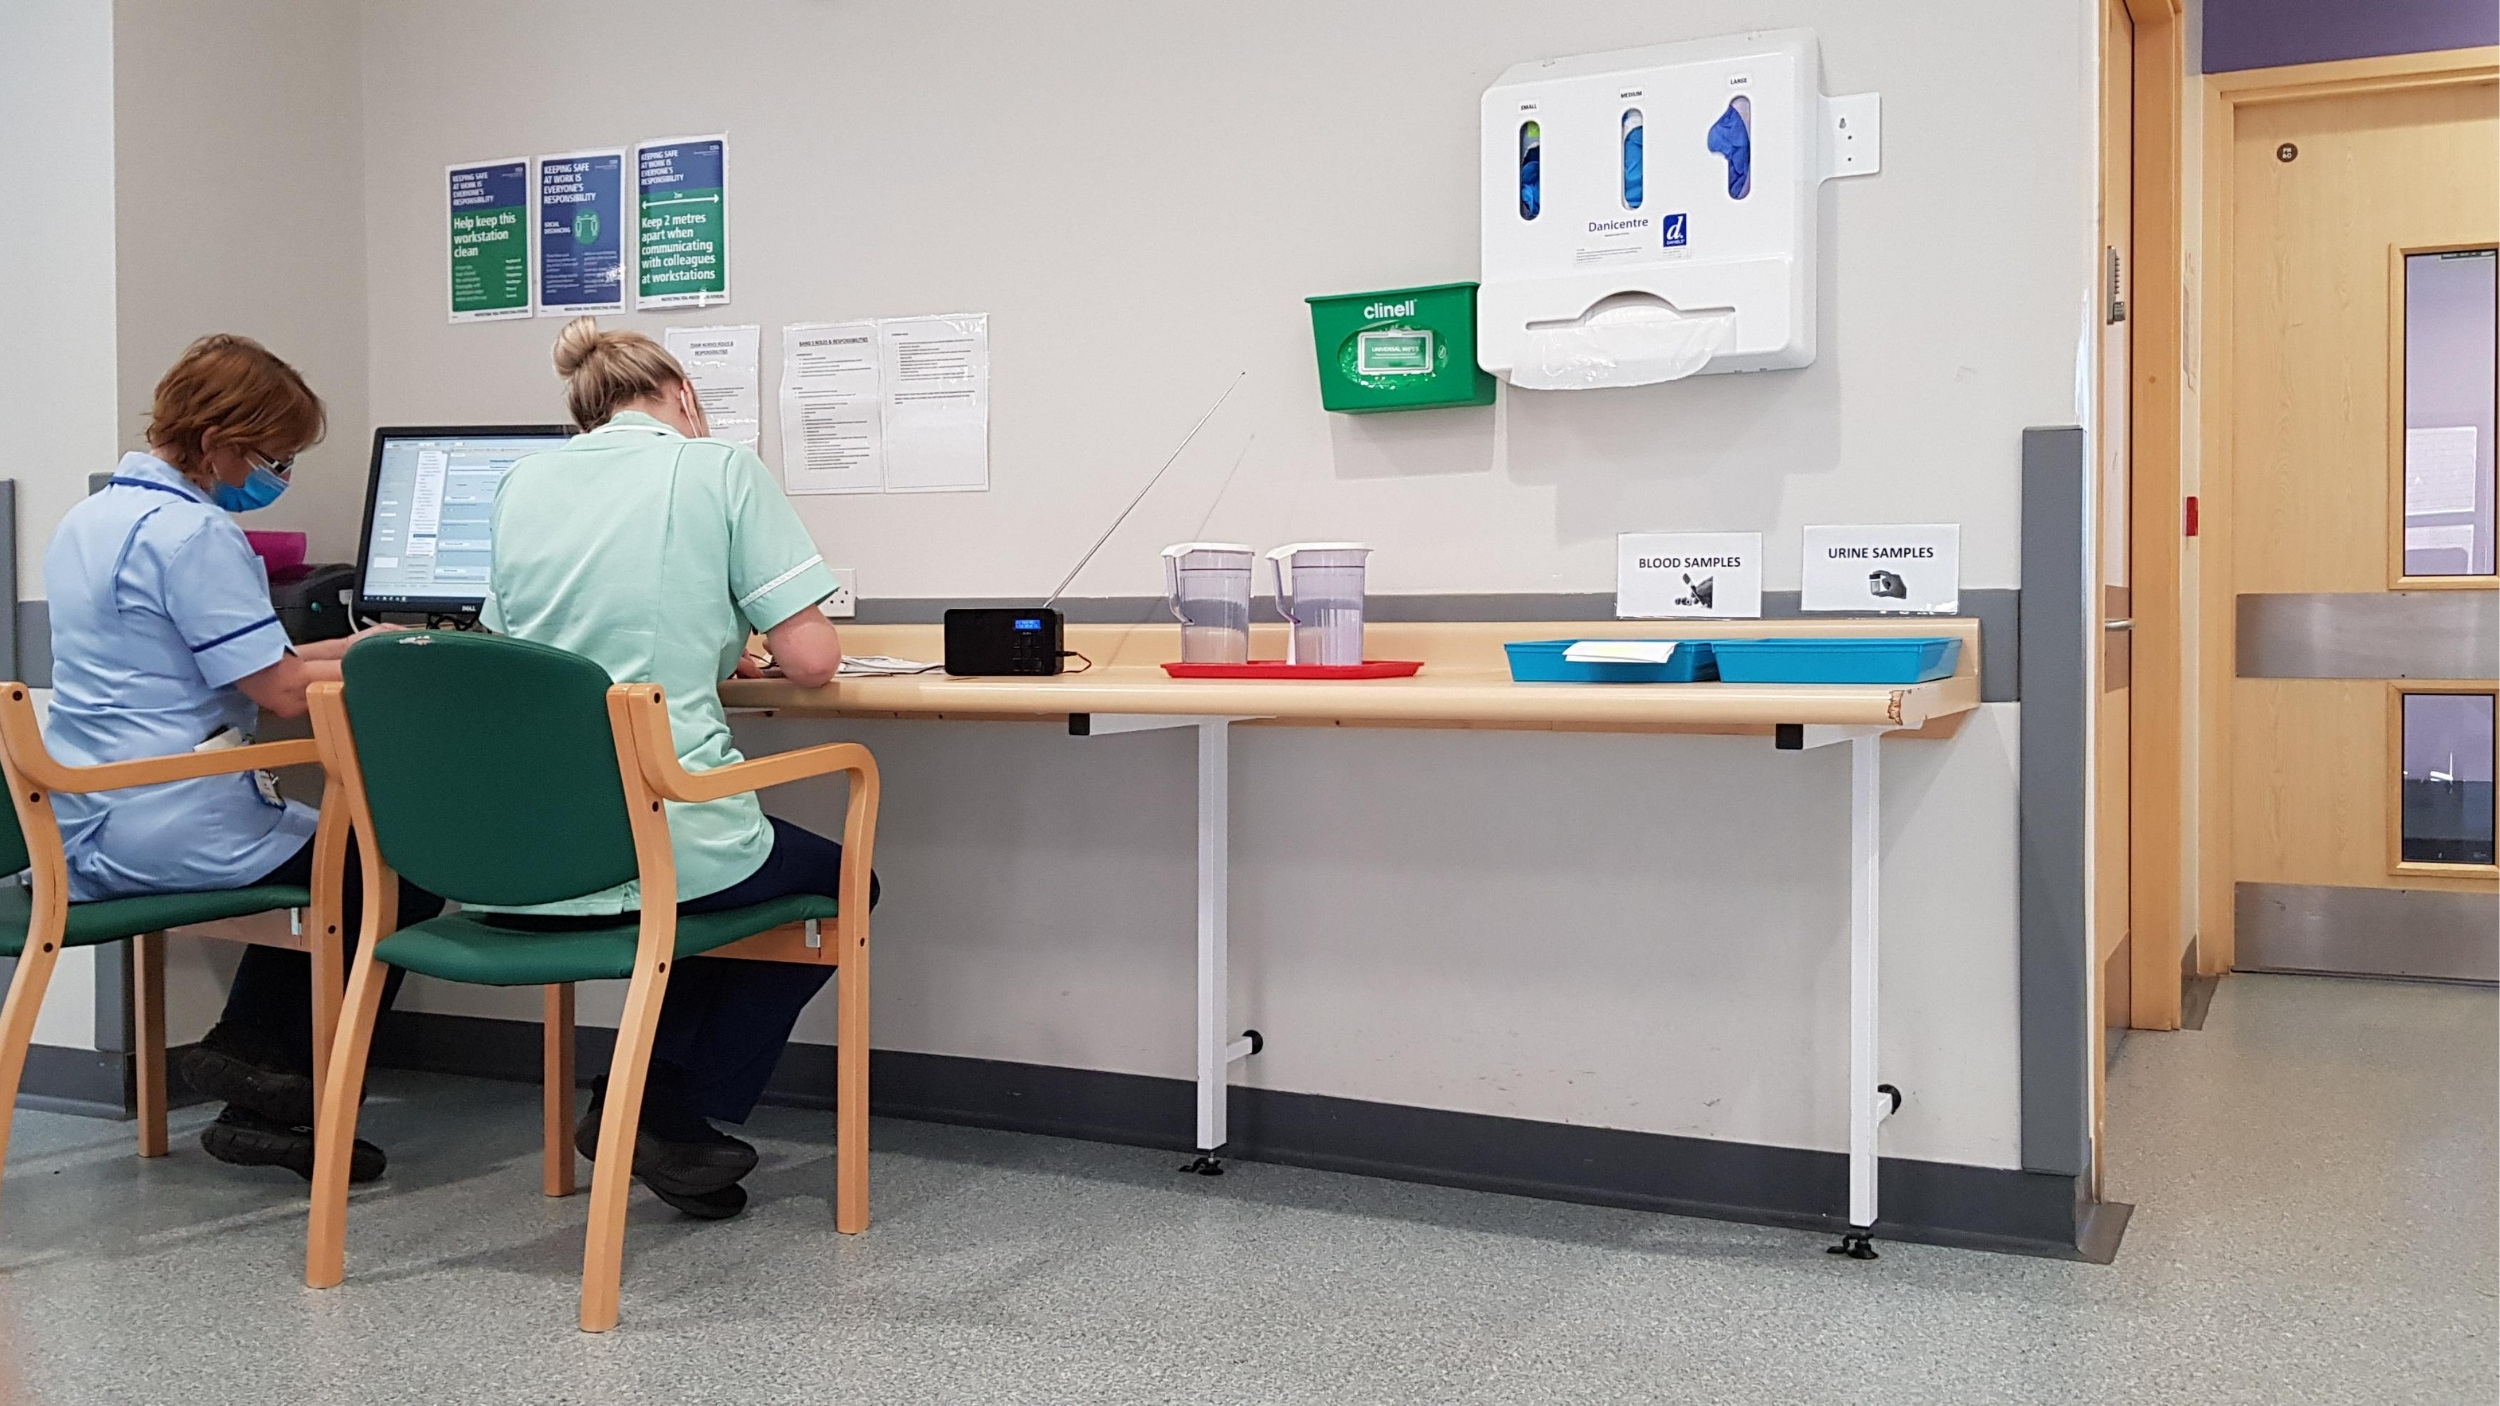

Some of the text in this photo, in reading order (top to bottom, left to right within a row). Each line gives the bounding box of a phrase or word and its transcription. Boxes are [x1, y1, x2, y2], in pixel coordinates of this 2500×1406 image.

[641, 151, 663, 160] KEEPING
[544, 164, 572, 174] KEEPING
[573, 163, 590, 172] SAFE
[544, 174, 582, 184] AT WORK IS
[641, 174, 684, 185] RESPONSIBILITY
[544, 183, 584, 194] EVERYONE'S
[453, 195, 494, 206] RESPONSIBILITY
[544, 192, 596, 204] RESPONSIBILITY
[454, 212, 516, 231] Help keep this
[642, 213, 706, 229] Keep 2 metres
[1588, 218, 1649, 232] Danicentre
[454, 229, 509, 244] workstation
[642, 227, 694, 244] apart when
[454, 246, 478, 258] clean
[642, 239, 713, 255] communicating
[642, 254, 716, 269] with colleagues
[642, 268, 715, 284] at workstations
[1363, 300, 1415, 319] clinell
[1828, 547, 1934, 558] URINE SAMPLES
[1639, 557, 1741, 568] BLOOD SAMPLES
